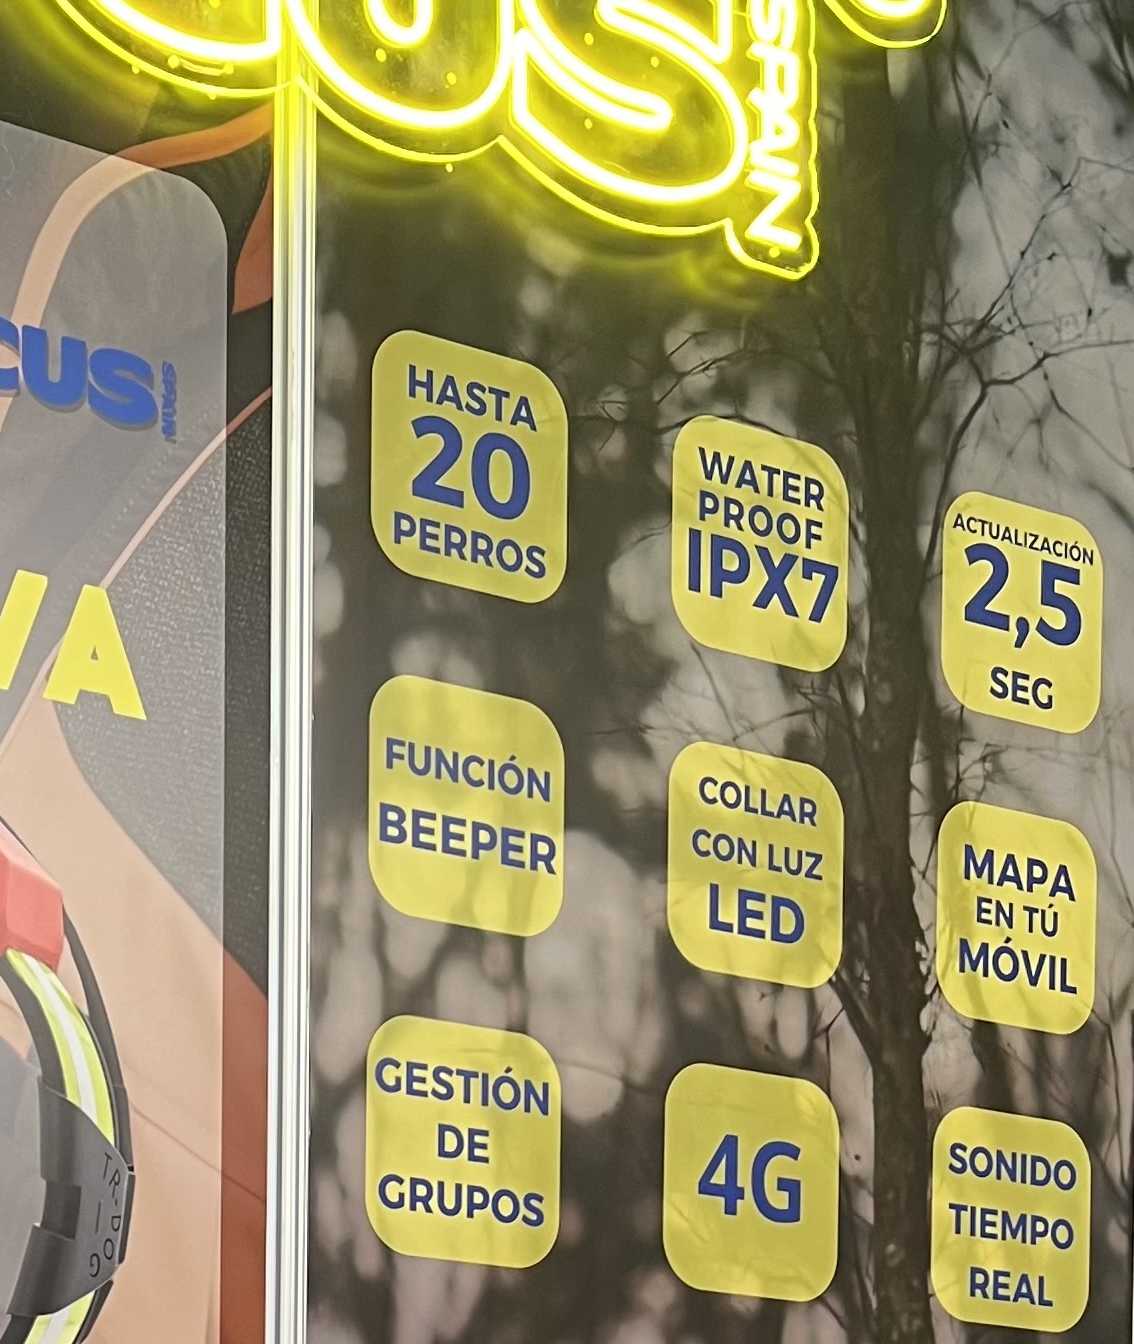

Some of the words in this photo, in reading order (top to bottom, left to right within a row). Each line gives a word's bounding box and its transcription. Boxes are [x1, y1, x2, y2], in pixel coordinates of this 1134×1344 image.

[408, 365, 536, 432] HASTA
[411, 416, 531, 520] 20
[698, 448, 824, 510] WATER
[393, 512, 546, 579] PERROS
[698, 491, 823, 548] PROOF
[953, 514, 1094, 565] ACTUALIZACIÓN
[688, 530, 839, 623] IPX7
[964, 543, 1082, 648] 2,5
[990, 667, 1053, 710] SEG
[385, 738, 551, 801] FUNCIÓN
[699, 776, 817, 826] COLLAR
[379, 804, 556, 874] BEEPER
[692, 829, 761, 866] CON
[768, 844, 823, 880] LUZ
[964, 845, 1075, 901] MAPA
[709, 884, 805, 944] LED
[976, 896, 1015, 928] EN
[1022, 901, 1058, 937] TÚ
[958, 939, 1077, 994] MÓVIL
[374, 1058, 550, 1116] GESTIÓN
[437, 1125, 489, 1164] DE
[949, 1143, 1076, 1191] SONIDO
[378, 1175, 544, 1227] GRUPOS
[698, 1134, 802, 1223] 4G
[949, 1204, 1074, 1250] TIEMPO
[969, 1267, 1053, 1307] REAL
